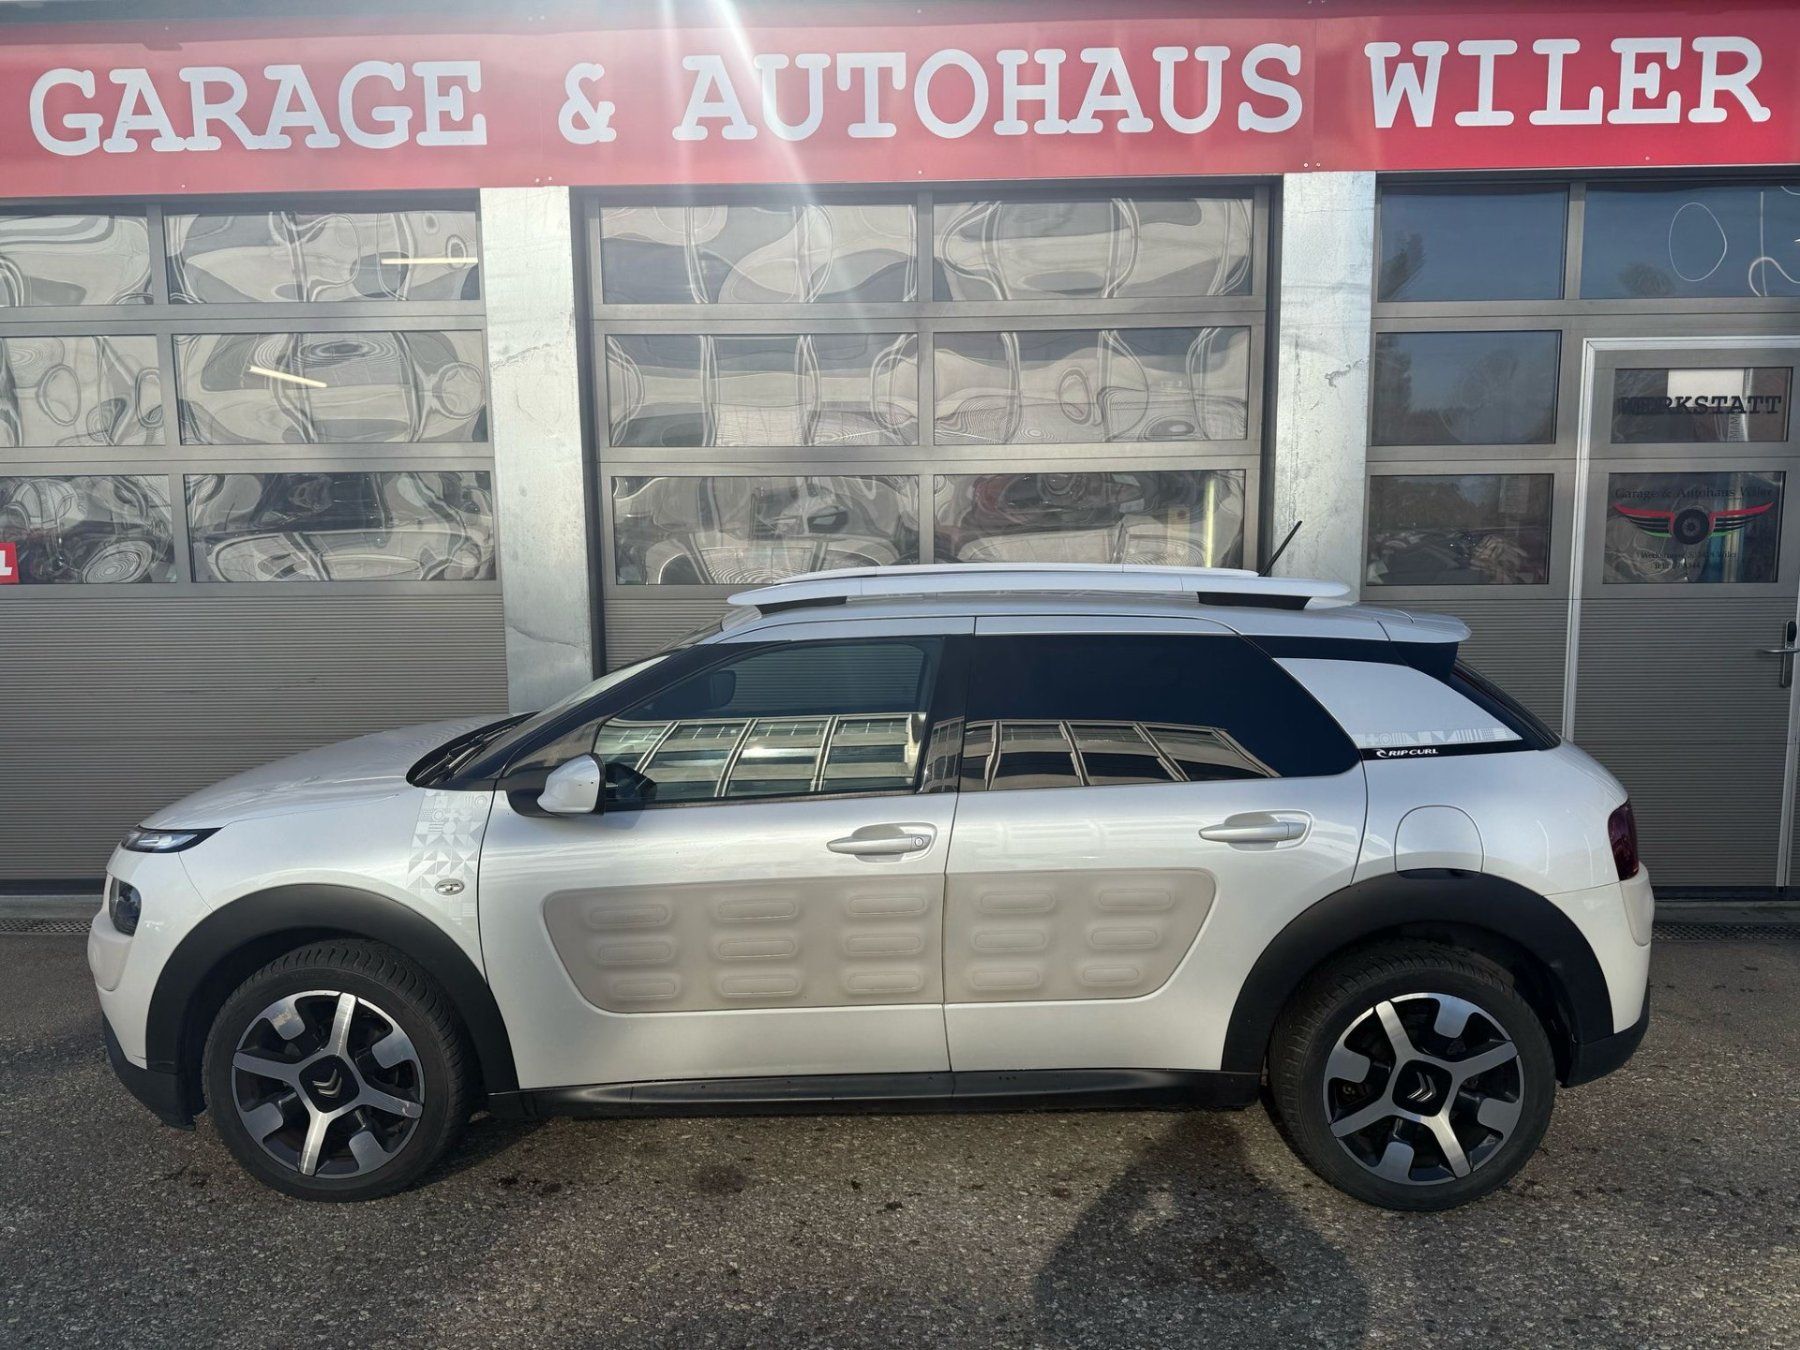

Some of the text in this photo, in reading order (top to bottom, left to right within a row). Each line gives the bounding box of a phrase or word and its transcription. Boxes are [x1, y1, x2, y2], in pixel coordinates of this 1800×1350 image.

[29, 36, 1771, 156] GARAGE & AUTOHAUS WILER
[1409, 748, 1439, 756] CURL
